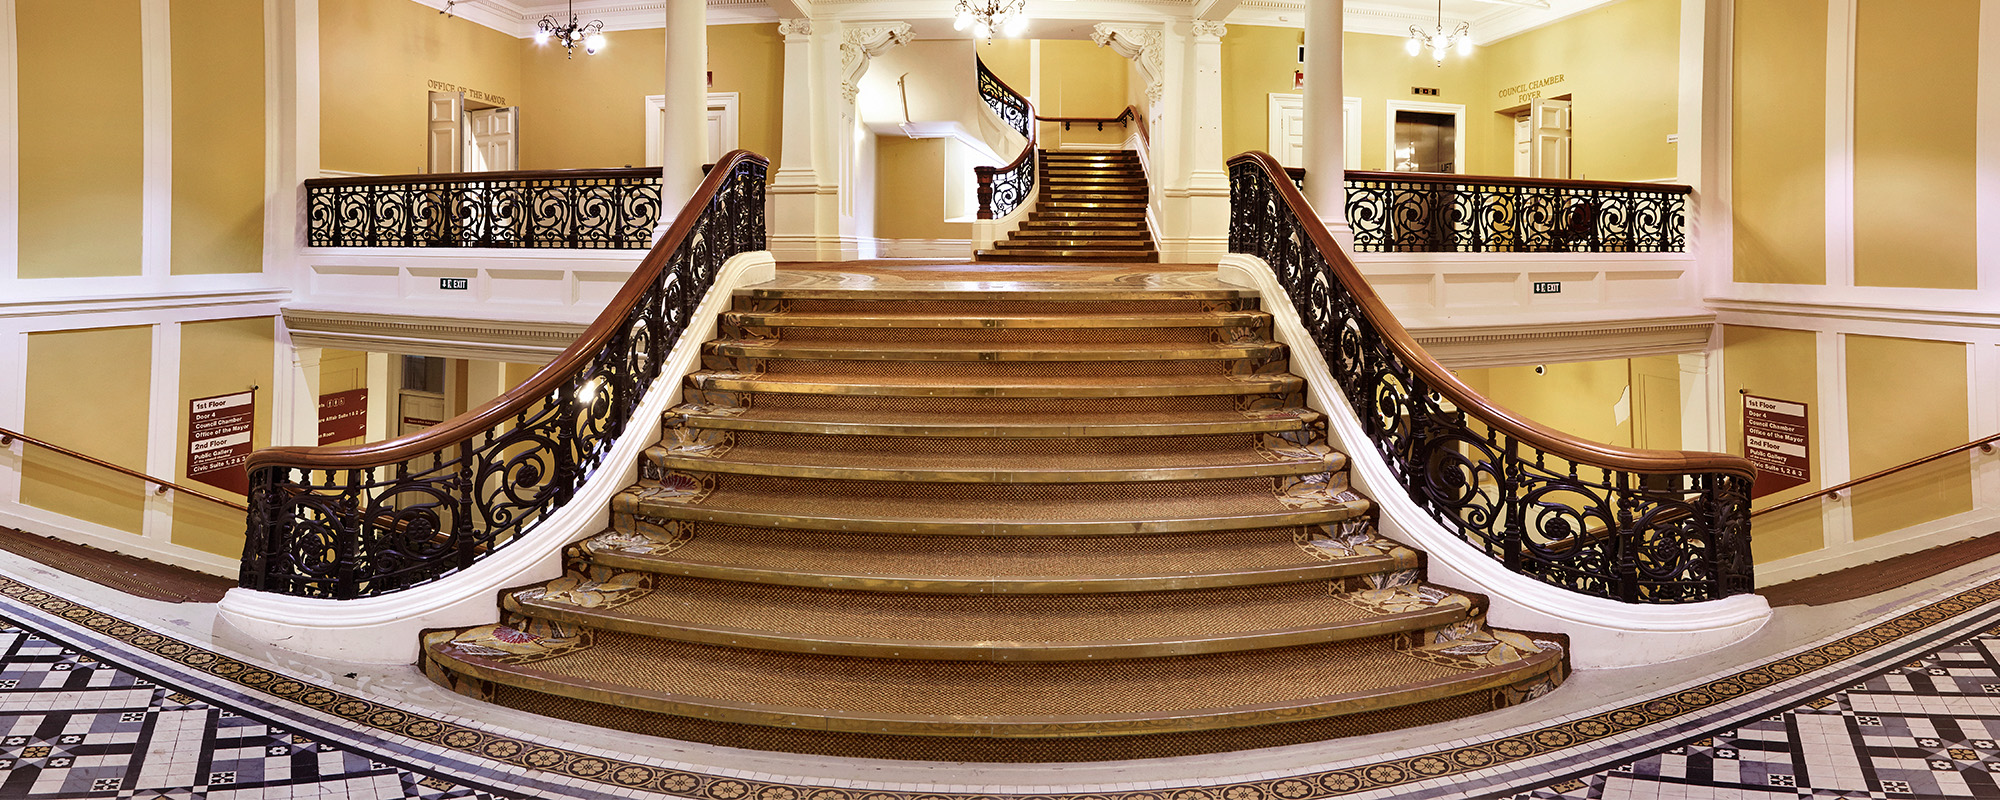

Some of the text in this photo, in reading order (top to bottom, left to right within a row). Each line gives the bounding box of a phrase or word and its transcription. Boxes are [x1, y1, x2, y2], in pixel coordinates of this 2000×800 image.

[1498, 74, 1564, 98] COUNCIL CHAMBER
[428, 79, 455, 92] OFFICE
[469, 89, 482, 99] THE
[484, 92, 506, 105] MAYOR
[1518, 90, 1541, 103] FOYER
[1441, 162, 1452, 172] LIFT
[454, 280, 466, 288] EXIT
[1548, 284, 1560, 292] EXIT
[196, 417, 242, 429] Council Chamber
[1769, 422, 1795, 432] Chamber
[195, 430, 214, 438] Office
[1749, 428, 1766, 436] Office
[194, 441, 208, 450] 2nd
[1763, 442, 1780, 450] Floor
[1750, 449, 1766, 457] Public
[1767, 452, 1787, 462] Gallery
